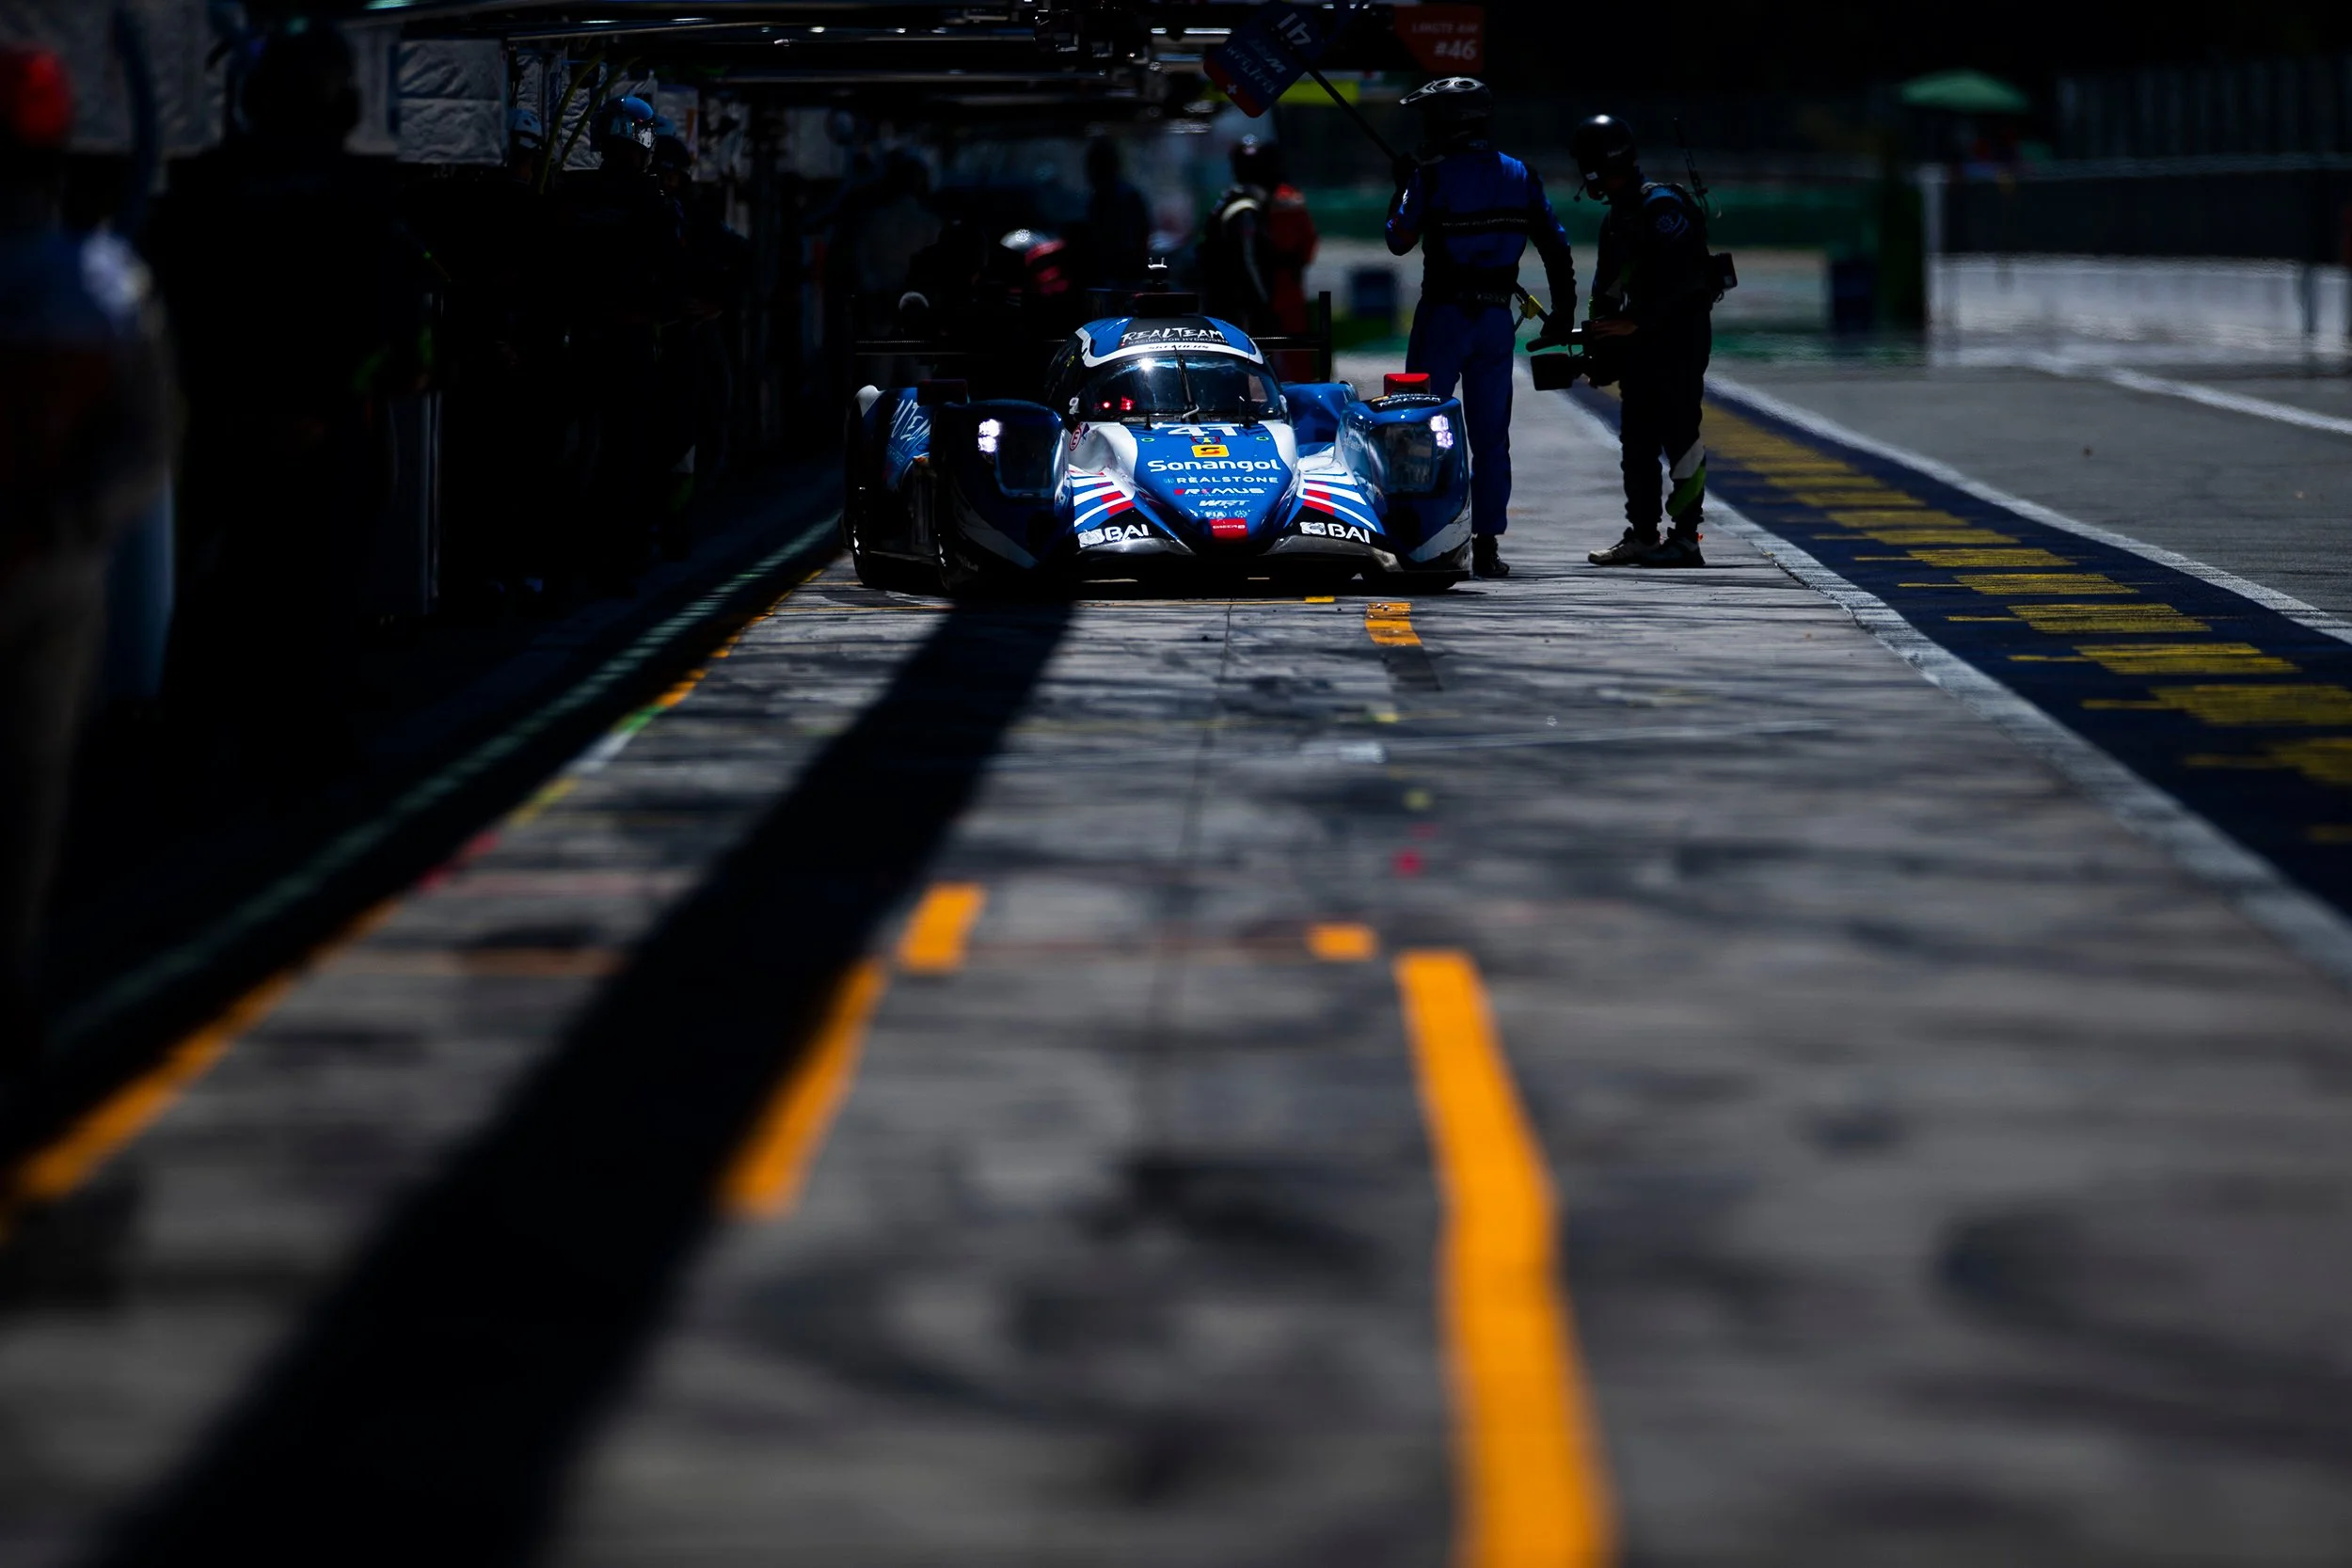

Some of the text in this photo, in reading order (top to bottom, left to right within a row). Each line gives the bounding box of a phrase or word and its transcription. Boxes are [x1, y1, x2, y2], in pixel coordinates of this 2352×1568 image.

[1434, 39, 1477, 61] #46
[1120, 327, 1225, 341] REALTEAM
[1147, 459, 1281, 472] Sonangol
[1104, 523, 1150, 542] BAI
[1327, 523, 1371, 545] BAI
